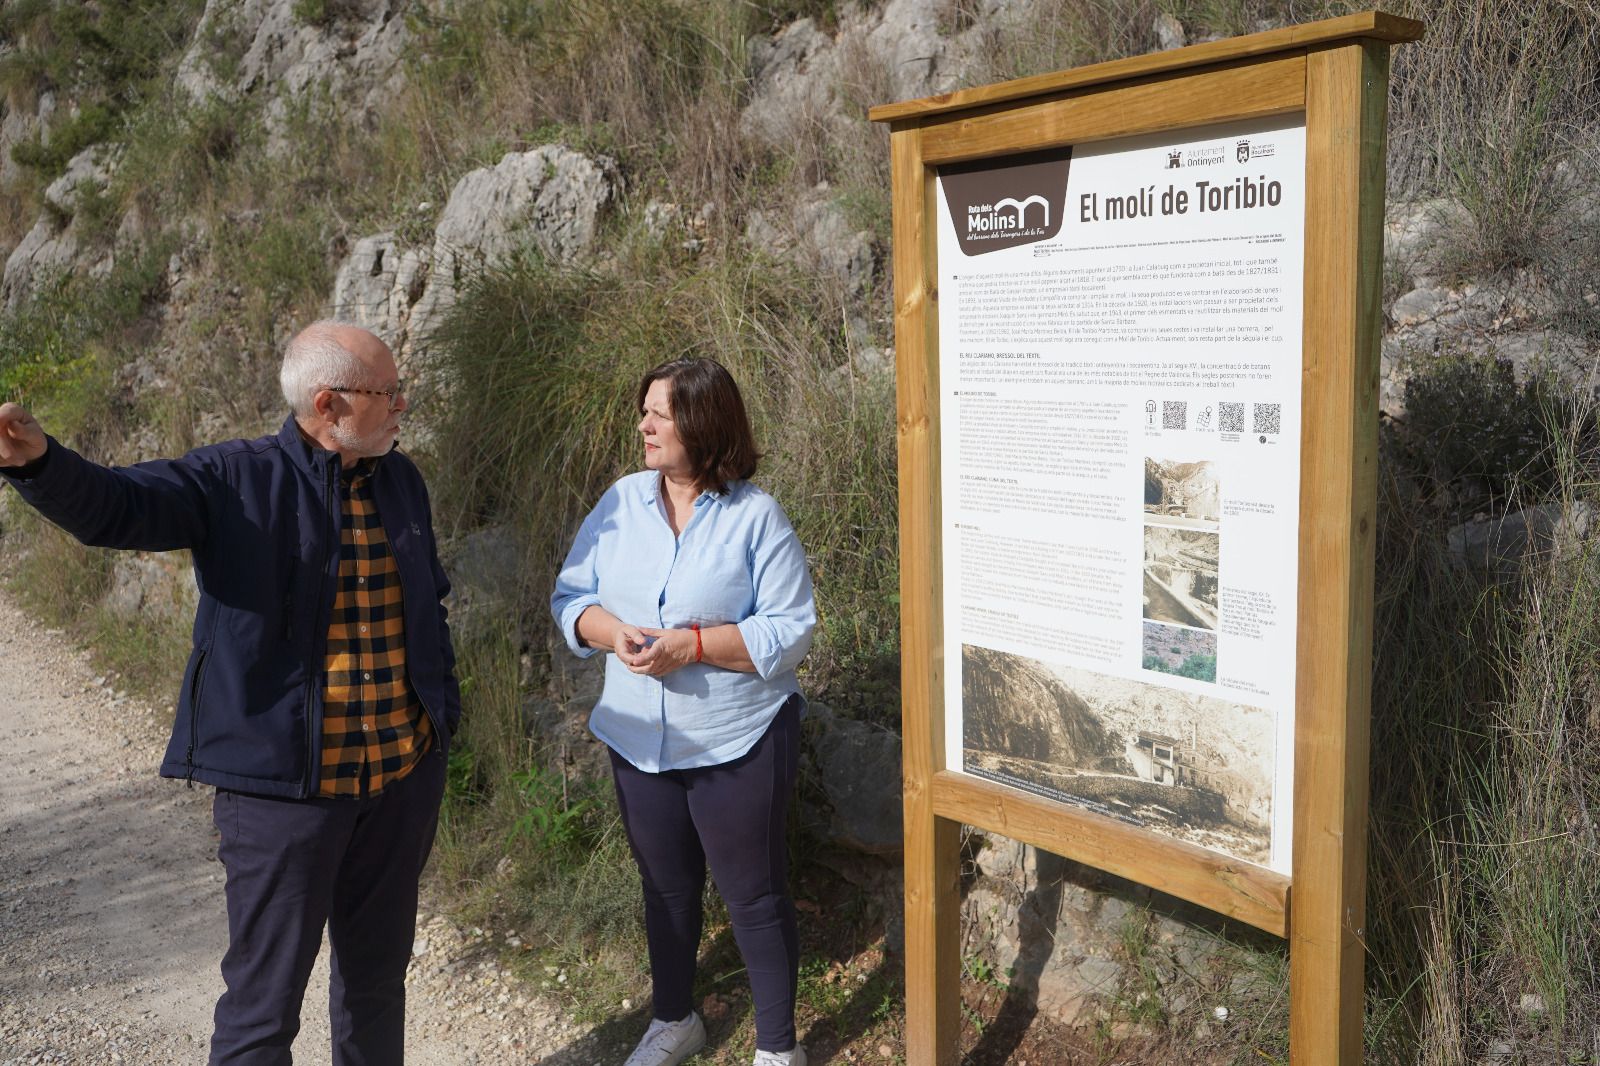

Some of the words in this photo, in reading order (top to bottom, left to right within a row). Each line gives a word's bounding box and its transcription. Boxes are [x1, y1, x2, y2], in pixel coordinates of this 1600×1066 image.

[1187, 154, 1224, 167] Ontinyent
[1080, 192, 1098, 222] El
[1106, 185, 1155, 220] molí
[1161, 185, 1188, 216] de
[1196, 175, 1281, 212] Toribio
[981, 204, 992, 212] dels
[968, 212, 1015, 232] Molins
